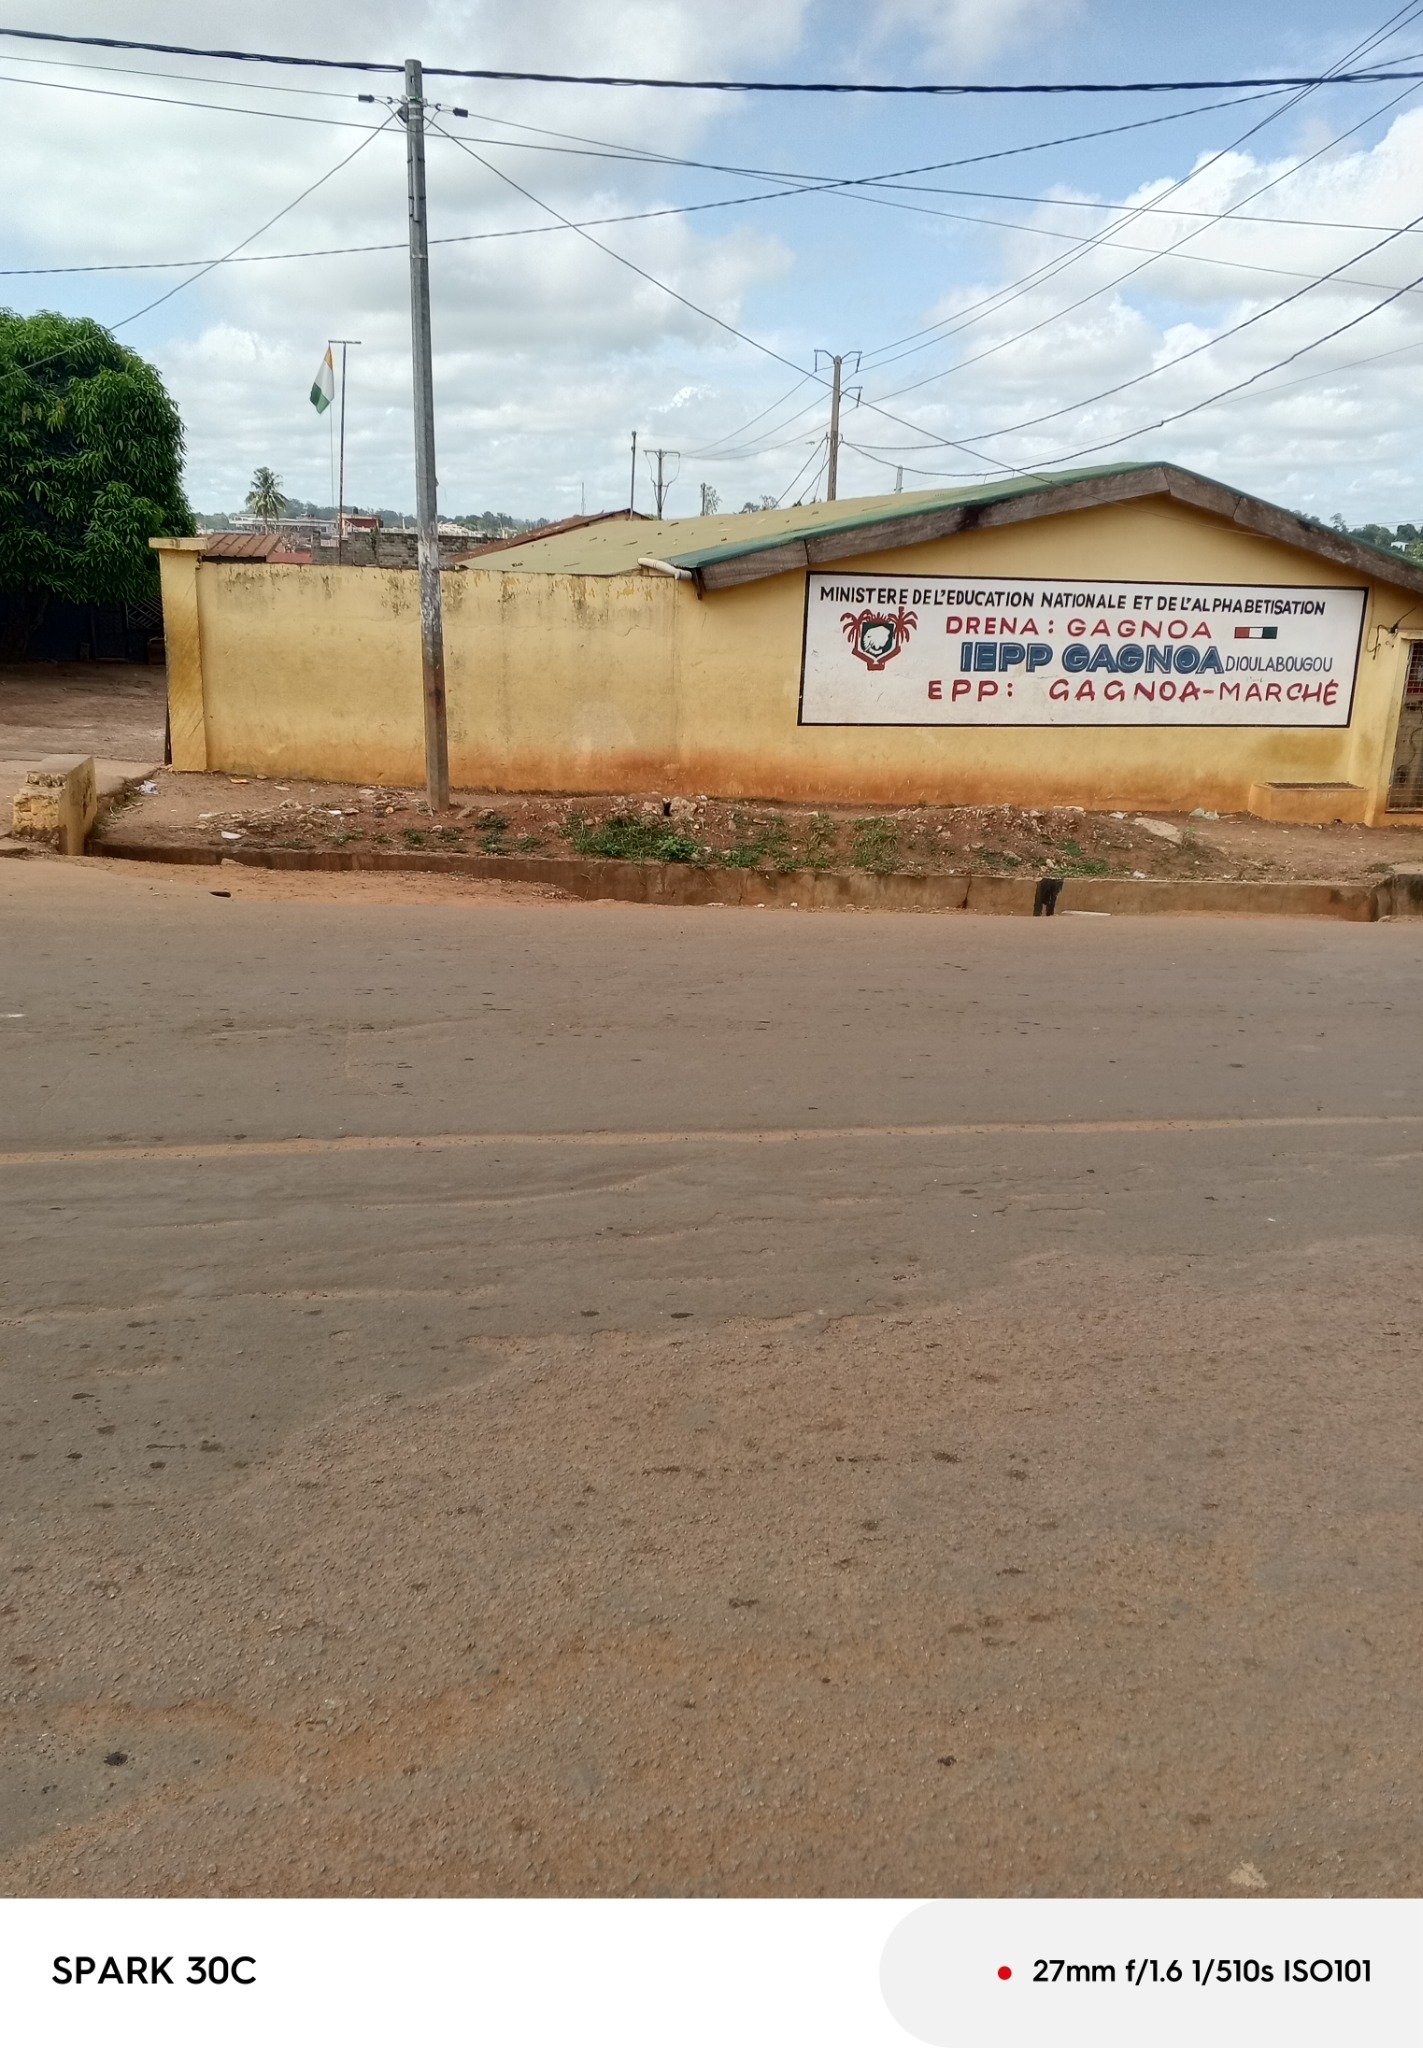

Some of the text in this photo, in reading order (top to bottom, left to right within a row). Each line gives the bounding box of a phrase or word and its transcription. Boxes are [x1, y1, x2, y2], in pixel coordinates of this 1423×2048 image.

[820, 586, 908, 605] MINISTERE
[912, 589, 932, 605] DE
[1040, 592, 1126, 610] NATIONALE
[1133, 595, 1153, 611] ET
[1157, 596, 1177, 612] DE
[1067, 618, 1212, 639] GAGNOA
[960, 641, 1334, 675] IEPP GAGNOA DIOULABOUGOU
[928, 678, 1339, 706] EPP: GAGNOA-MARCHÉ
